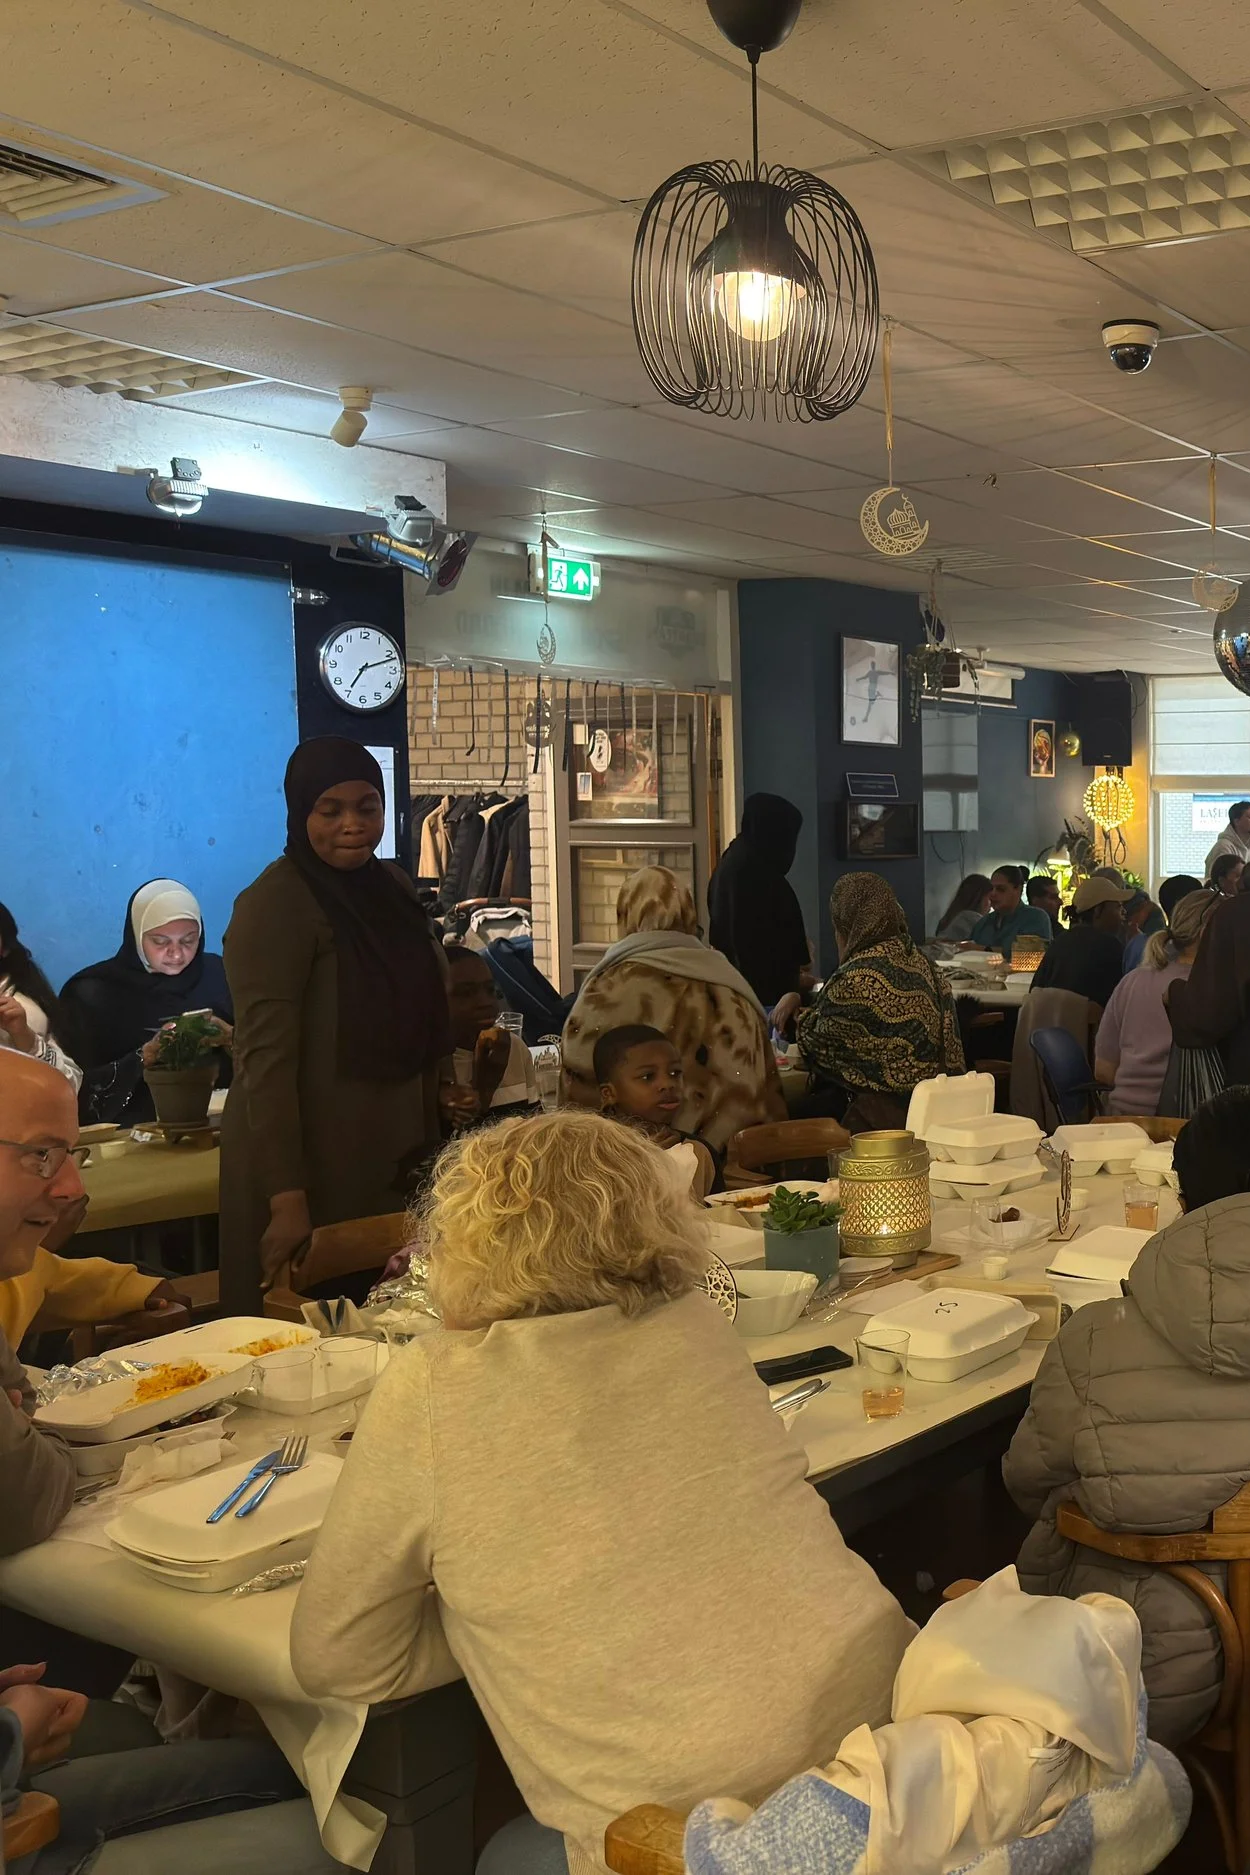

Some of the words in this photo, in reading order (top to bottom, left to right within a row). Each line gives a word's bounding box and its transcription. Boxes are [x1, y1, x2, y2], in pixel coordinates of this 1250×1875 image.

[346, 634, 353, 643] 11
[360, 631, 371, 640] 12
[378, 637, 381, 645] 1
[334, 645, 344, 653] 10
[385, 650, 393, 659] 2
[329, 660, 337, 669] 9
[389, 666, 397, 675] 3
[333, 677, 342, 685] 8
[344, 690, 352, 698] 7
[374, 692, 382, 700] 5
[359, 696, 367, 704] 6
